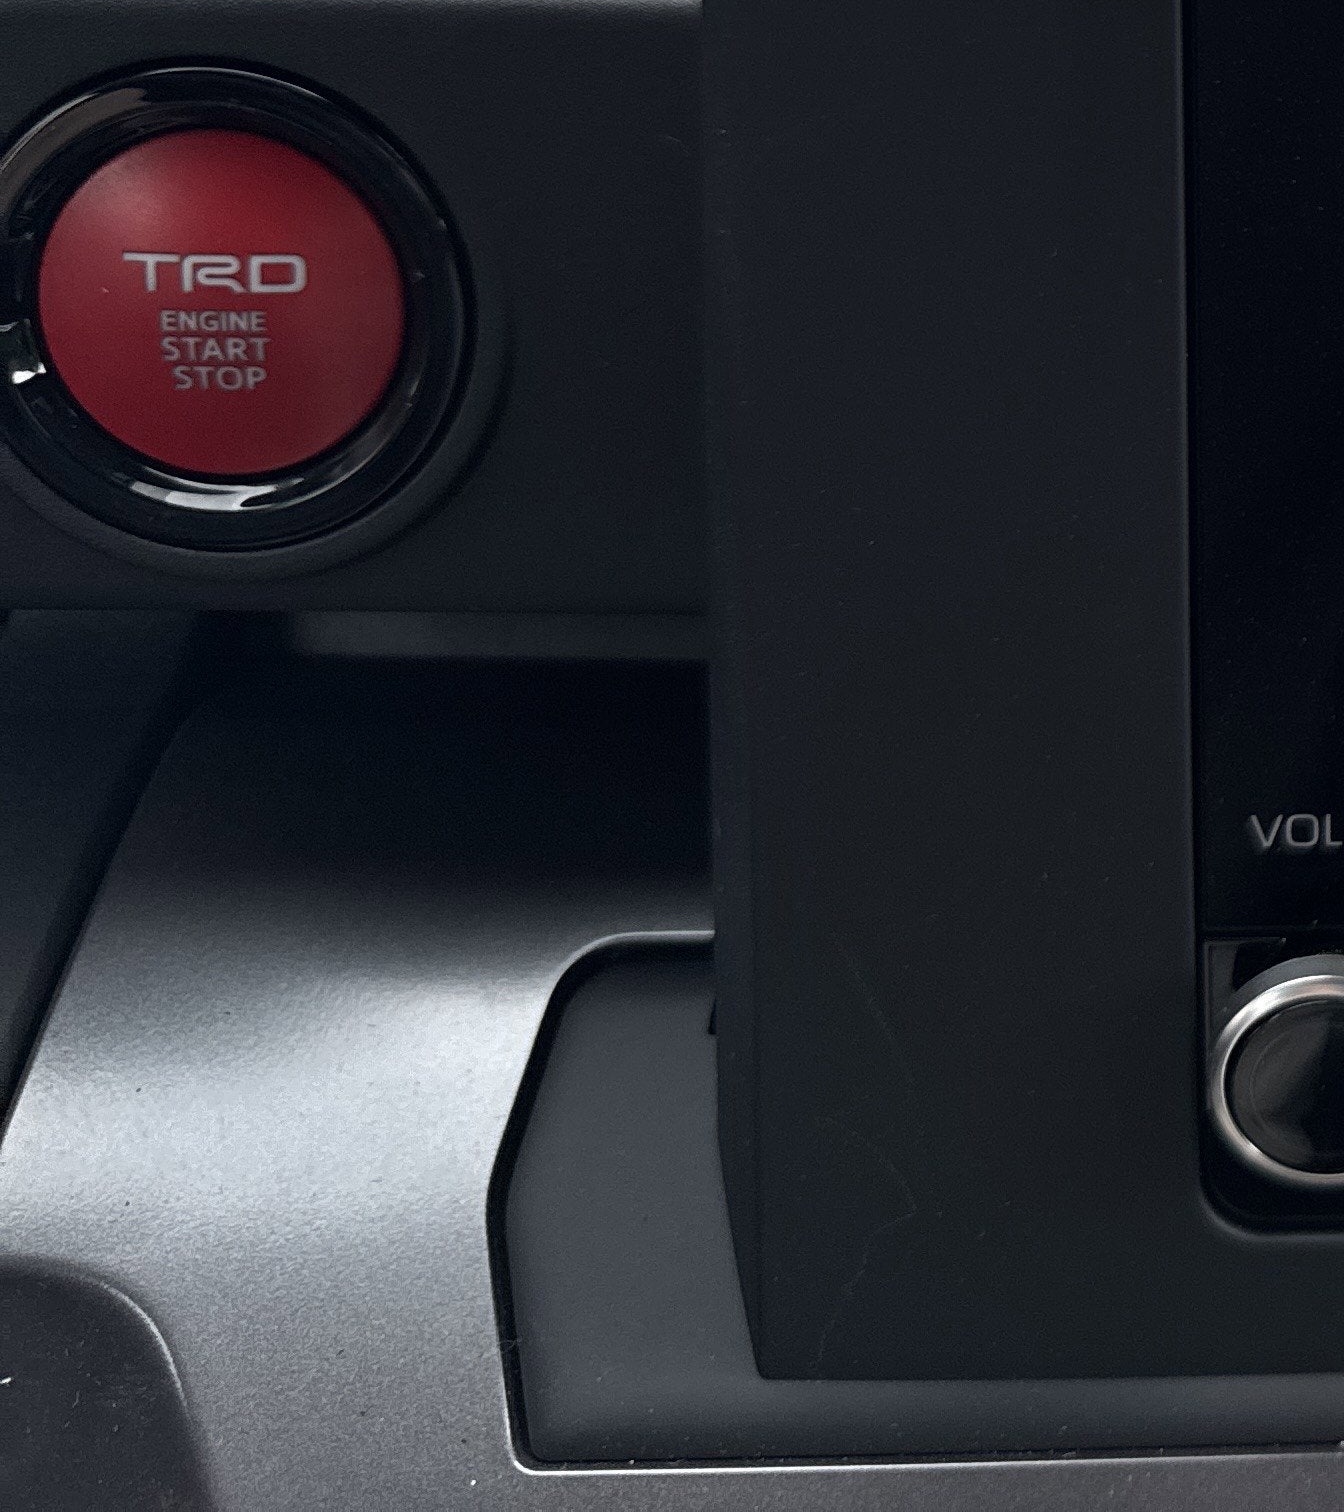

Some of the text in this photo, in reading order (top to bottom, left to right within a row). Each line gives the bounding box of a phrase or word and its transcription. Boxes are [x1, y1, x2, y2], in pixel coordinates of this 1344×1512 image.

[123, 252, 308, 294] TRD
[160, 310, 267, 333] ENGINE
[161, 337, 270, 362] START
[172, 365, 267, 390] STOP
[1250, 813, 1343, 848] VOL
